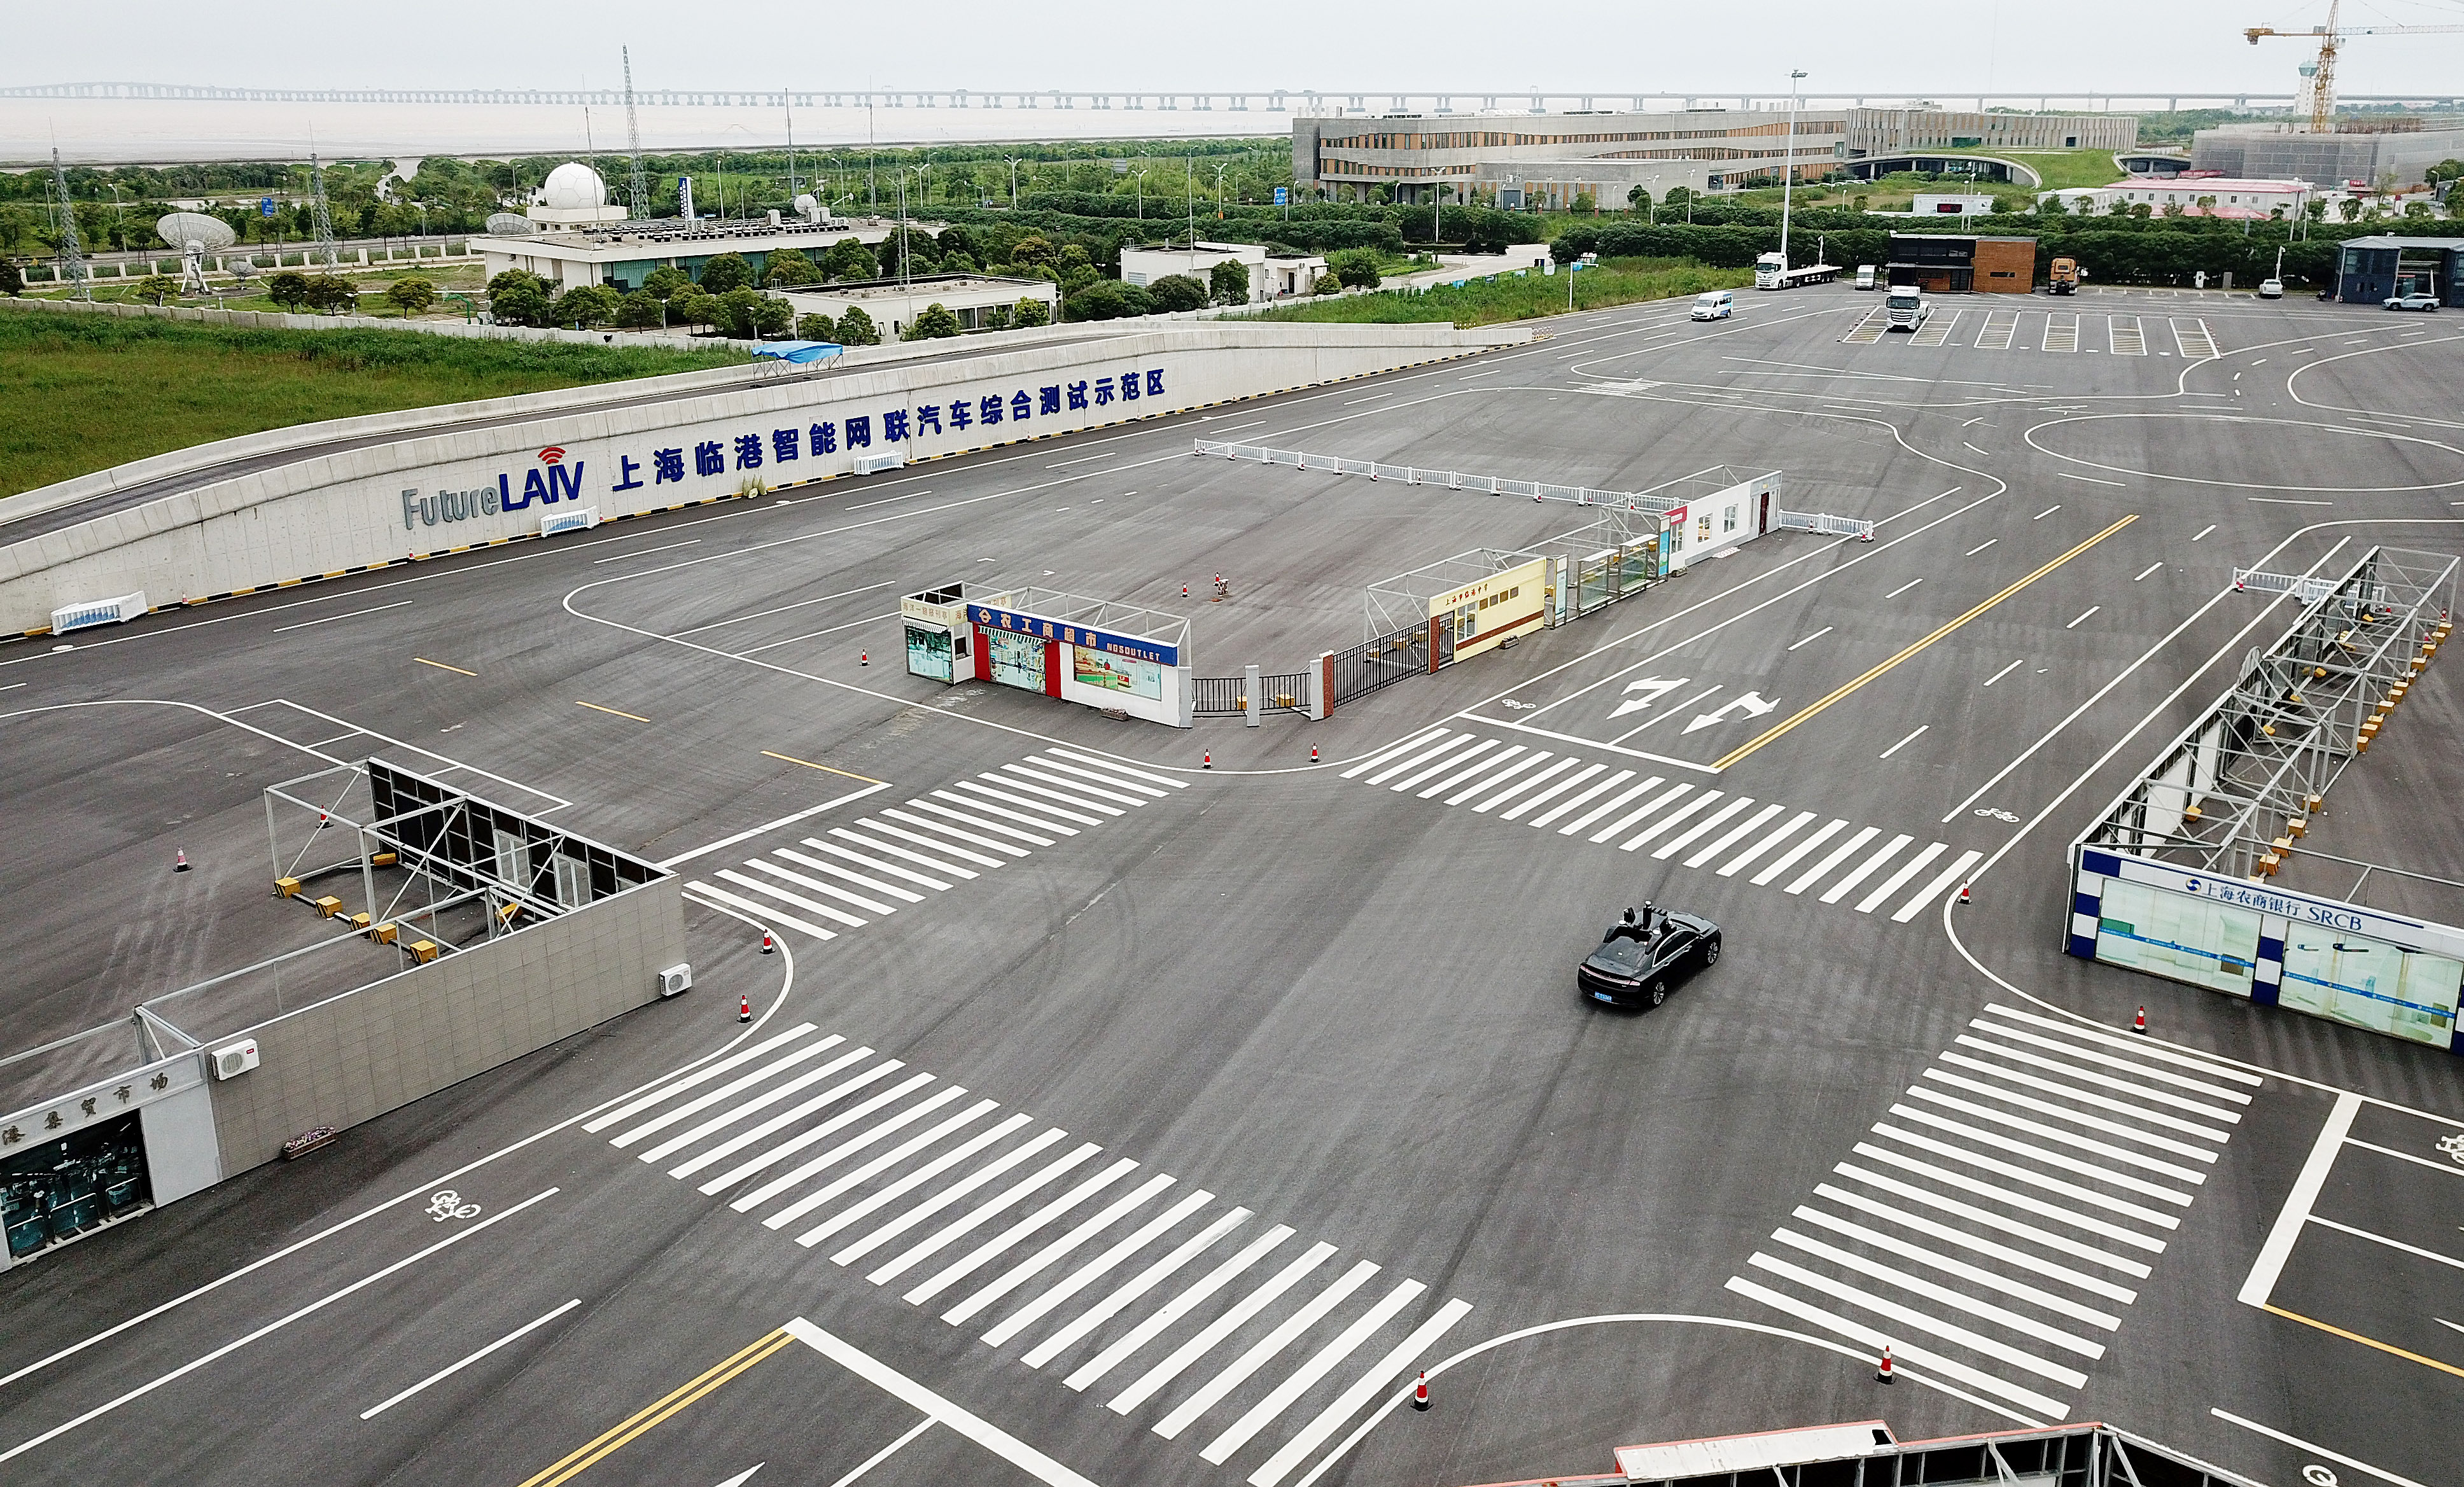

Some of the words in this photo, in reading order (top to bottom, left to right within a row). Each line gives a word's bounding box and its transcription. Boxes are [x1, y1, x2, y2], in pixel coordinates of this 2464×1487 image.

[612, 368, 1165, 492] 上海临港智能网联汽车综合测试示范区
[1000, 613, 1097, 647] 农工商超市
[1107, 643, 1160, 661] NGSOUTLET
[2202, 883, 2301, 916] 上海农商银行
[2307, 906, 2362, 931] SRCB
